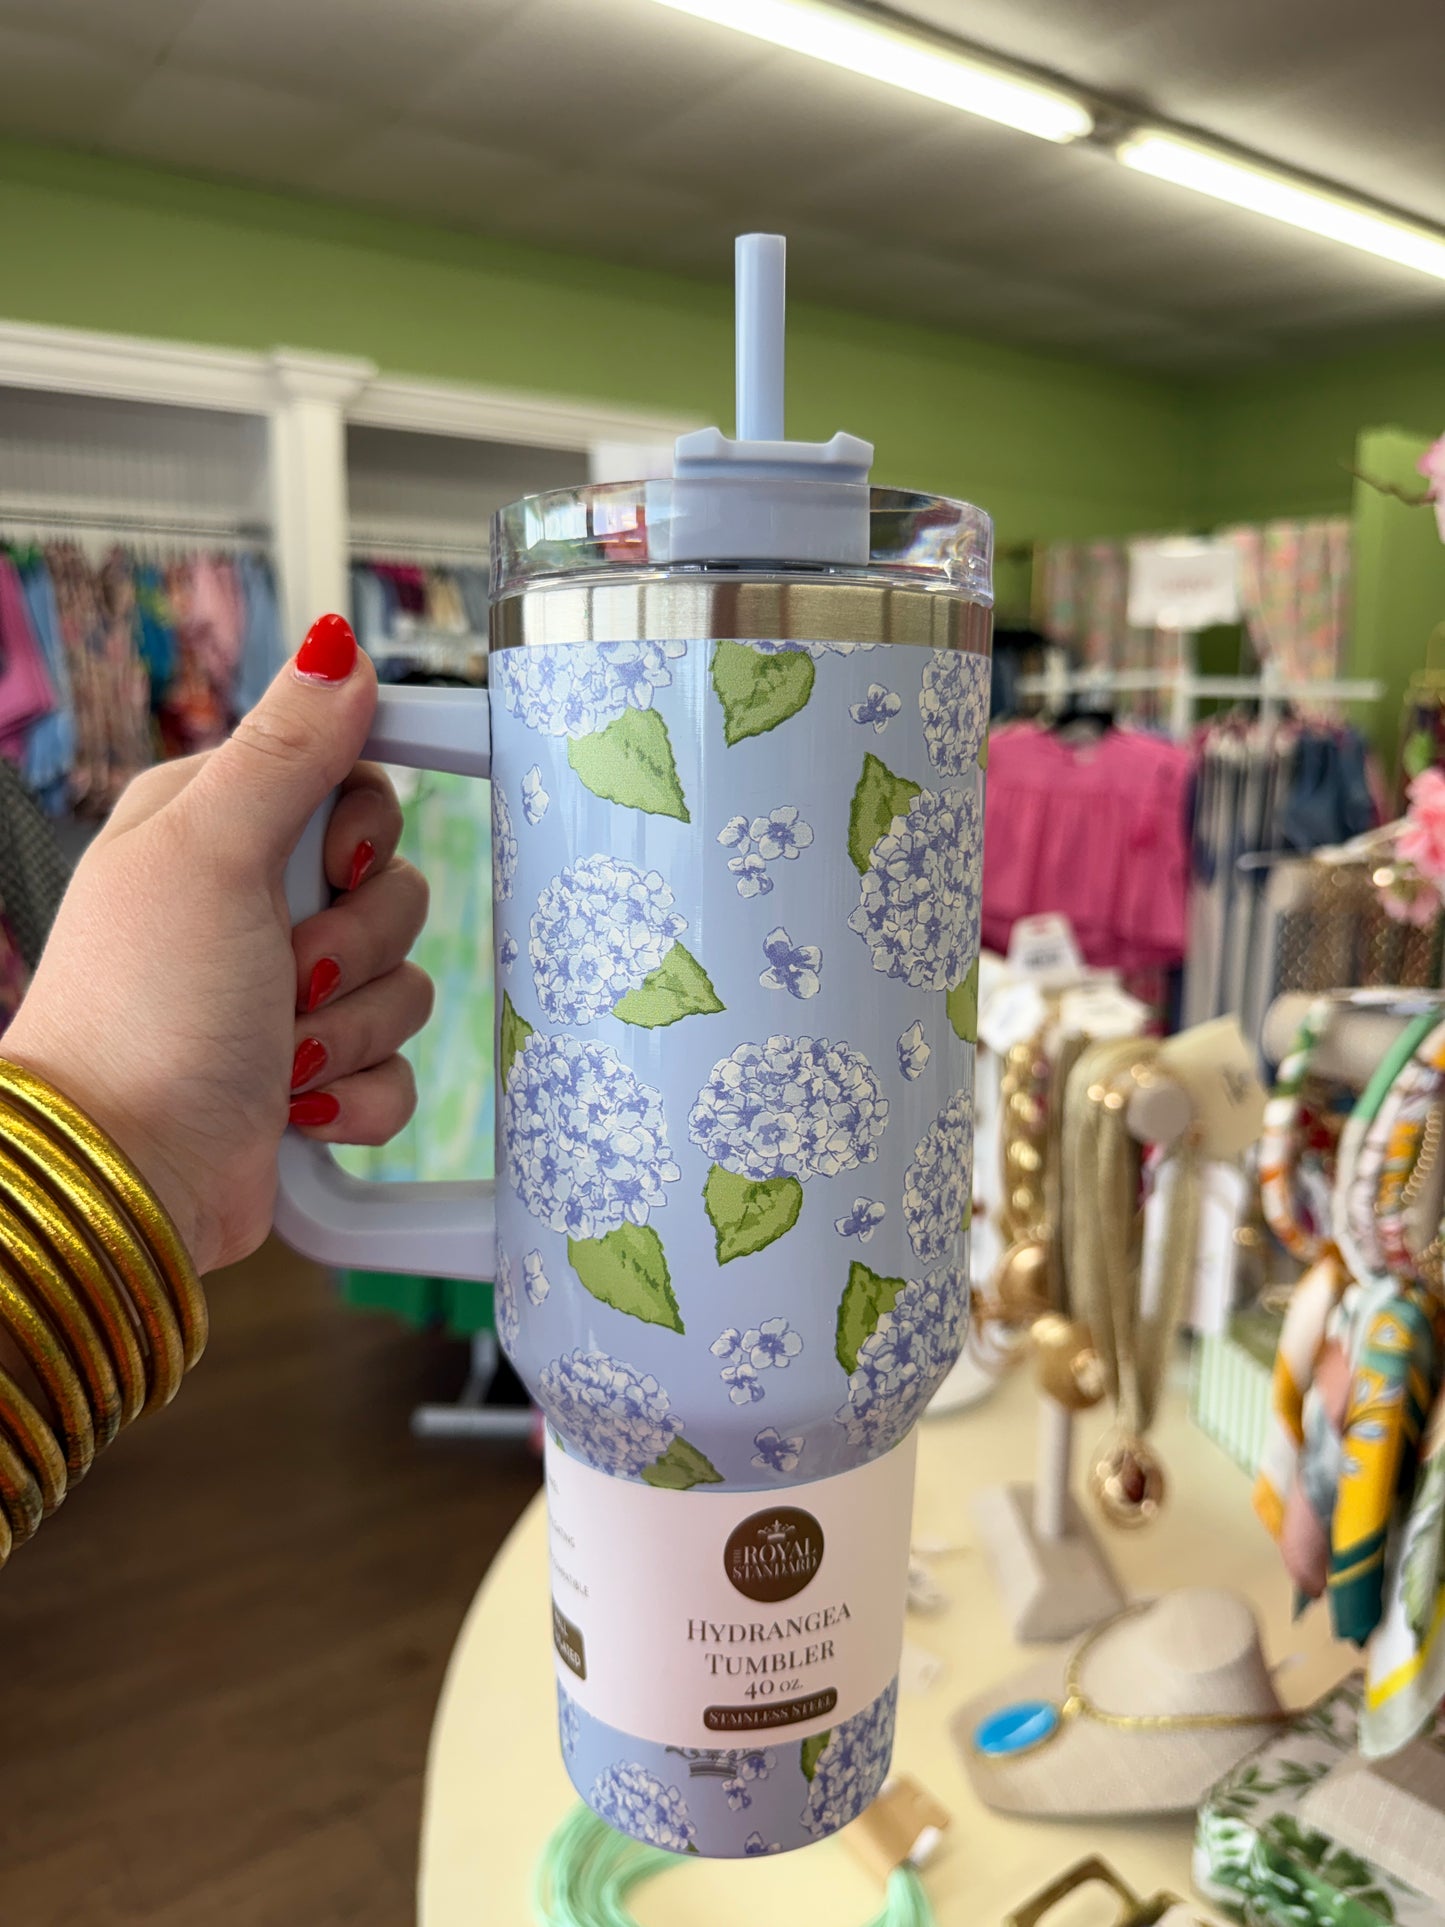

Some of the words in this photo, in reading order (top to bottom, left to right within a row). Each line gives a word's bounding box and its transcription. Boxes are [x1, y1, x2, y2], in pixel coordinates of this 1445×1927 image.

[744, 1537, 817, 1565] ROYAL
[733, 1556, 818, 1580] STANDARD
[687, 1602, 852, 1643] HYDRANGEA
[704, 1640, 836, 1676] TUMBLER
[744, 1679, 775, 1701] 40
[709, 1707, 789, 1725] STAINLESS
[792, 1694, 832, 1714] STEEL
